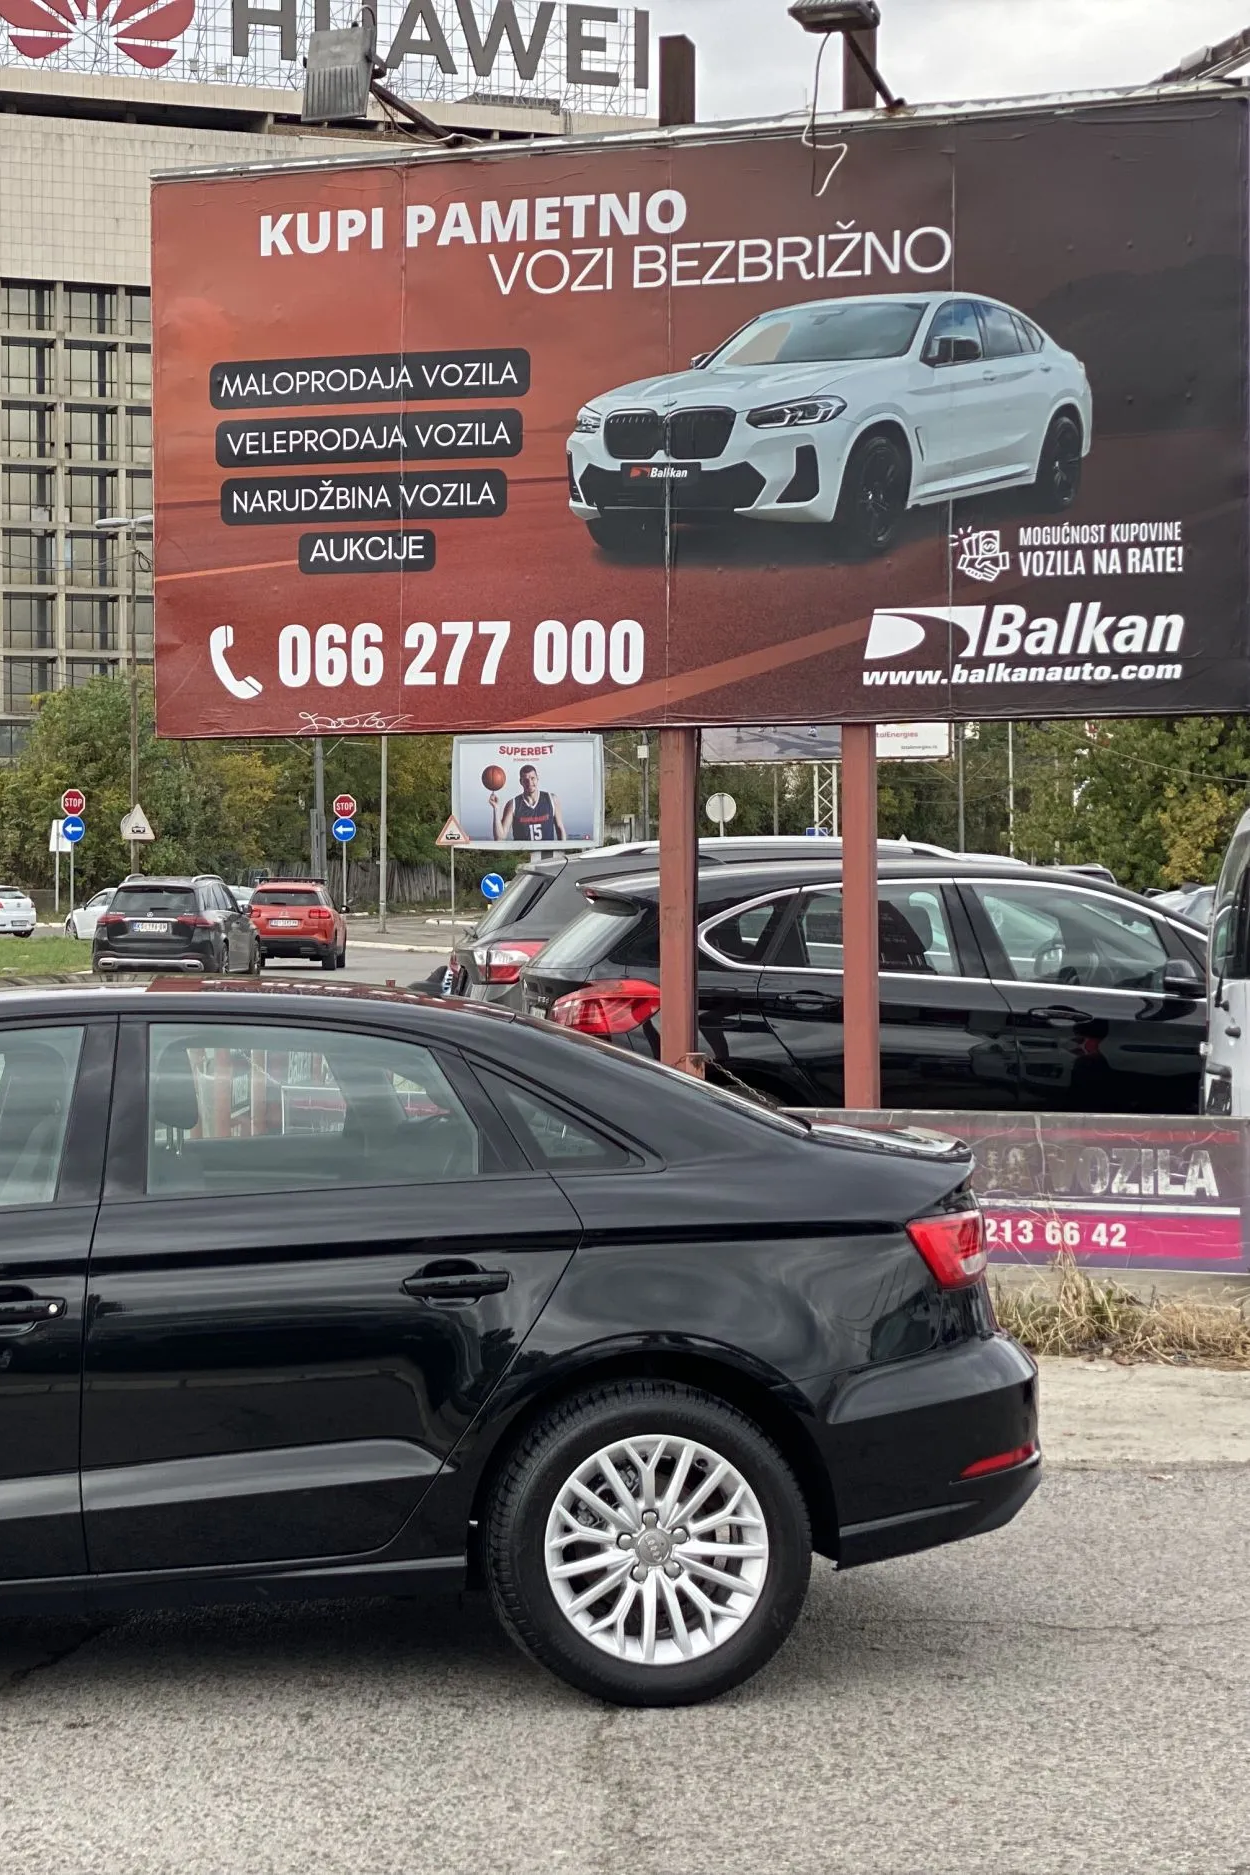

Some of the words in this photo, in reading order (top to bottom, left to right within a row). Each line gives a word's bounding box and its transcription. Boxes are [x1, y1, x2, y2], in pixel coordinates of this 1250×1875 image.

[233, 0, 650, 89] HAWEI
[260, 206, 384, 257] KUPI
[405, 189, 687, 248] PAMETNO
[488, 246, 614, 296] VOZI
[632, 219, 952, 289] BEZBRIŽNO
[220, 364, 414, 398] MALOPRODAJA
[421, 361, 519, 389] VOZILA
[226, 425, 408, 456] VELEPRODAJA
[414, 421, 512, 448] VOZILA
[650, 467, 688, 478] Balkan
[232, 479, 392, 514] NARUDŽBINA
[399, 481, 496, 508] VOZILA
[1018, 522, 1107, 546] MOGUĆNOST
[1110, 521, 1182, 543] KUPOVINE
[309, 535, 425, 563] AUKCIJE
[1019, 549, 1086, 577] VOZILA
[1093, 548, 1122, 575] NA
[1127, 546, 1184, 574] RATE!
[982, 601, 1186, 657] Balkan
[278, 622, 385, 688] 066
[403, 620, 511, 686] 277
[533, 619, 645, 686] 000
[862, 662, 1183, 686] www.balkanauto.com
[498, 744, 554, 756] SUPERBET
[876, 731, 919, 739] talEnergies
[64, 797, 83, 808] STOP
[336, 802, 354, 811] STOP
[529, 823, 543, 841] 15
[1049, 1146, 1221, 1198] VOZILA
[984, 1218, 1034, 1244] 213
[1045, 1221, 1081, 1246] 66
[1091, 1223, 1127, 1248] 42
